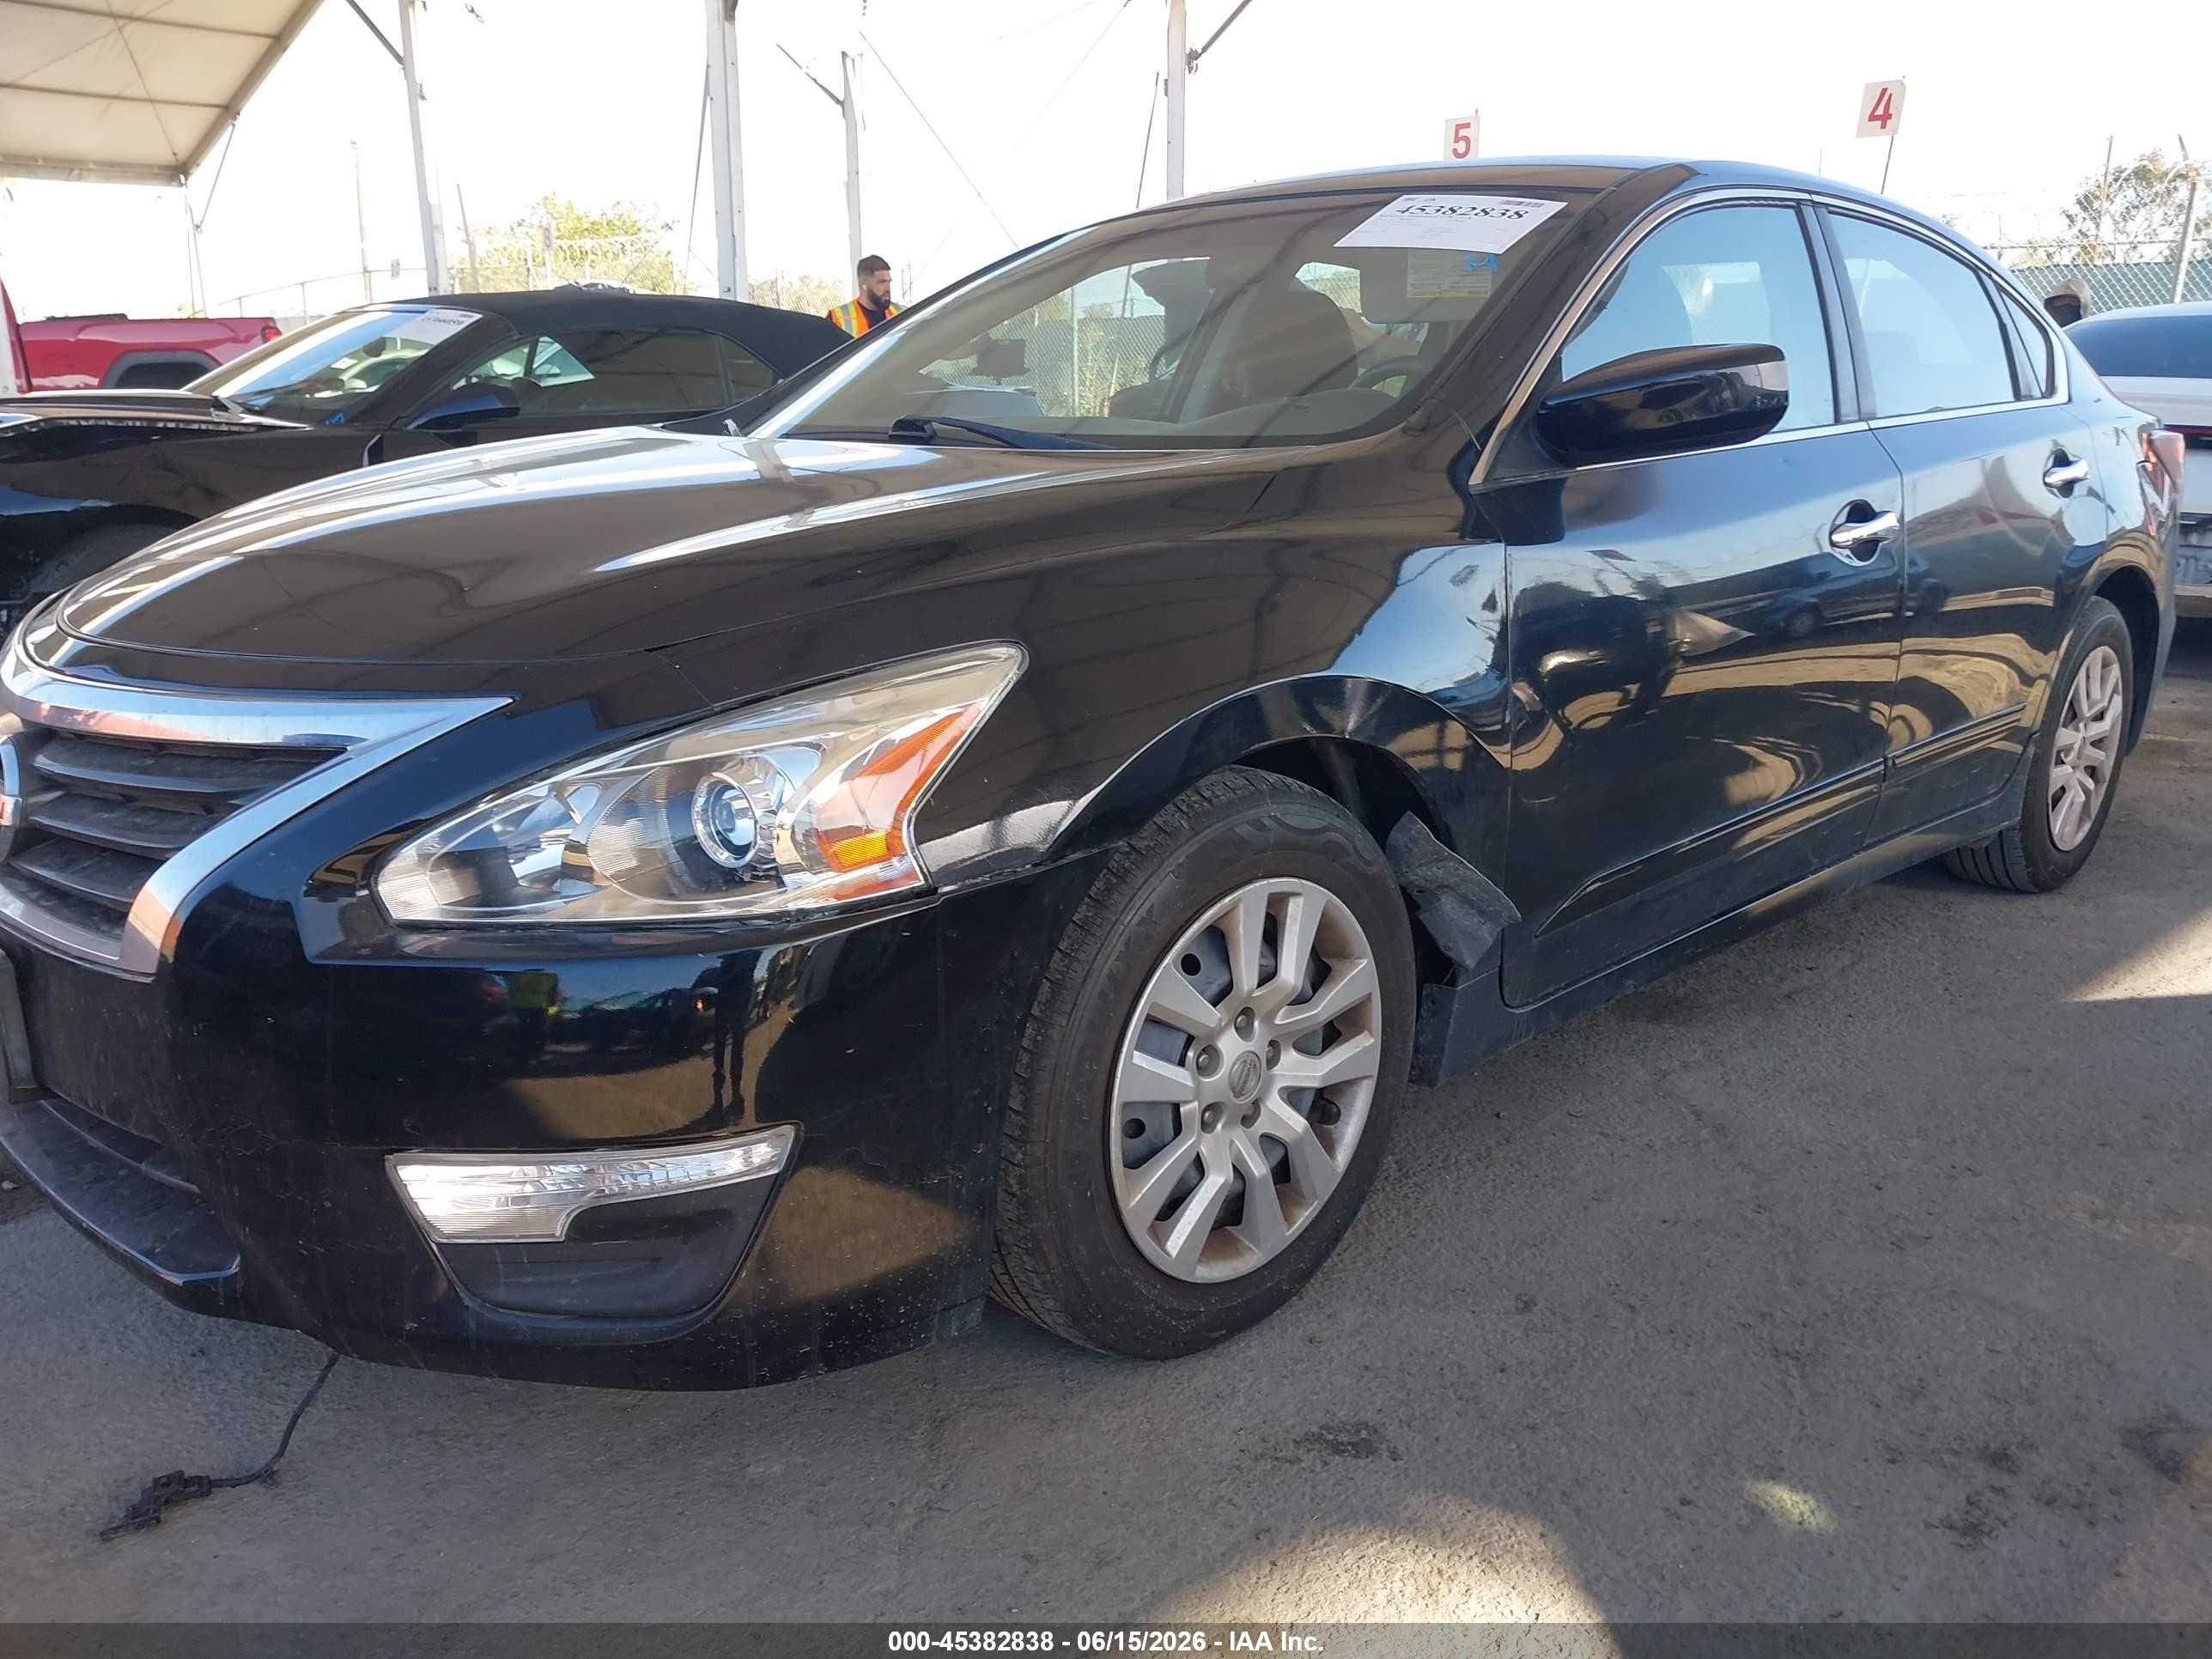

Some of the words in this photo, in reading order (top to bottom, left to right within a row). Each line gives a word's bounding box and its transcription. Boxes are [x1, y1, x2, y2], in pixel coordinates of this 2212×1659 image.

[1868, 87, 1893, 130] 4
[1452, 122, 1471, 159] 5
[1395, 204, 1529, 220] 45382838
